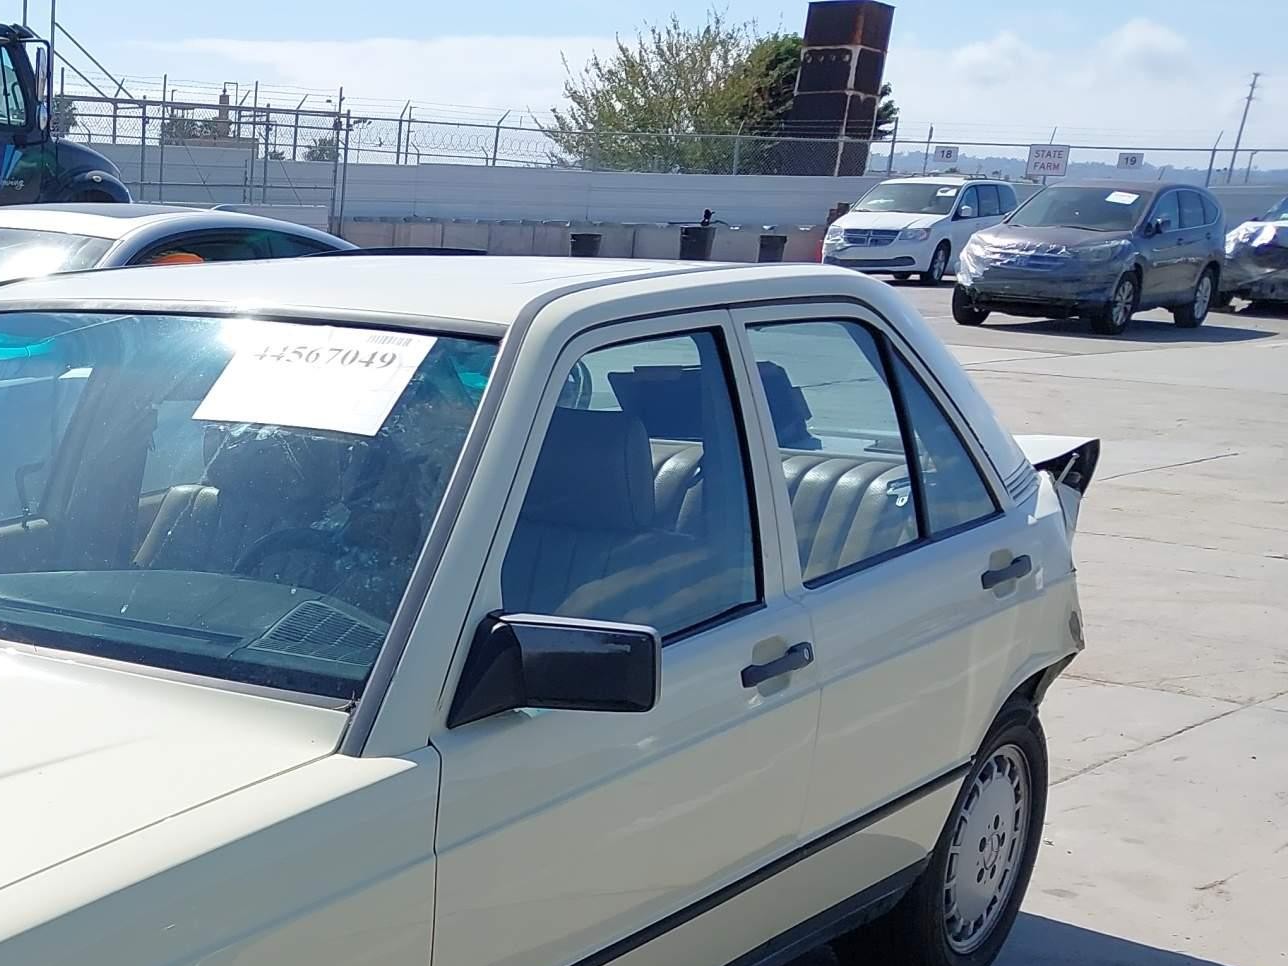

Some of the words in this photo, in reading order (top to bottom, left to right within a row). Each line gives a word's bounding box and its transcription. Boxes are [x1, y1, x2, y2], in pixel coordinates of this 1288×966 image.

[940, 150, 952, 159] 18
[1033, 150, 1063, 159] STATE
[1124, 157, 1137, 166] 19
[1033, 162, 1060, 171] FARM
[252, 345, 397, 369] 44567049
